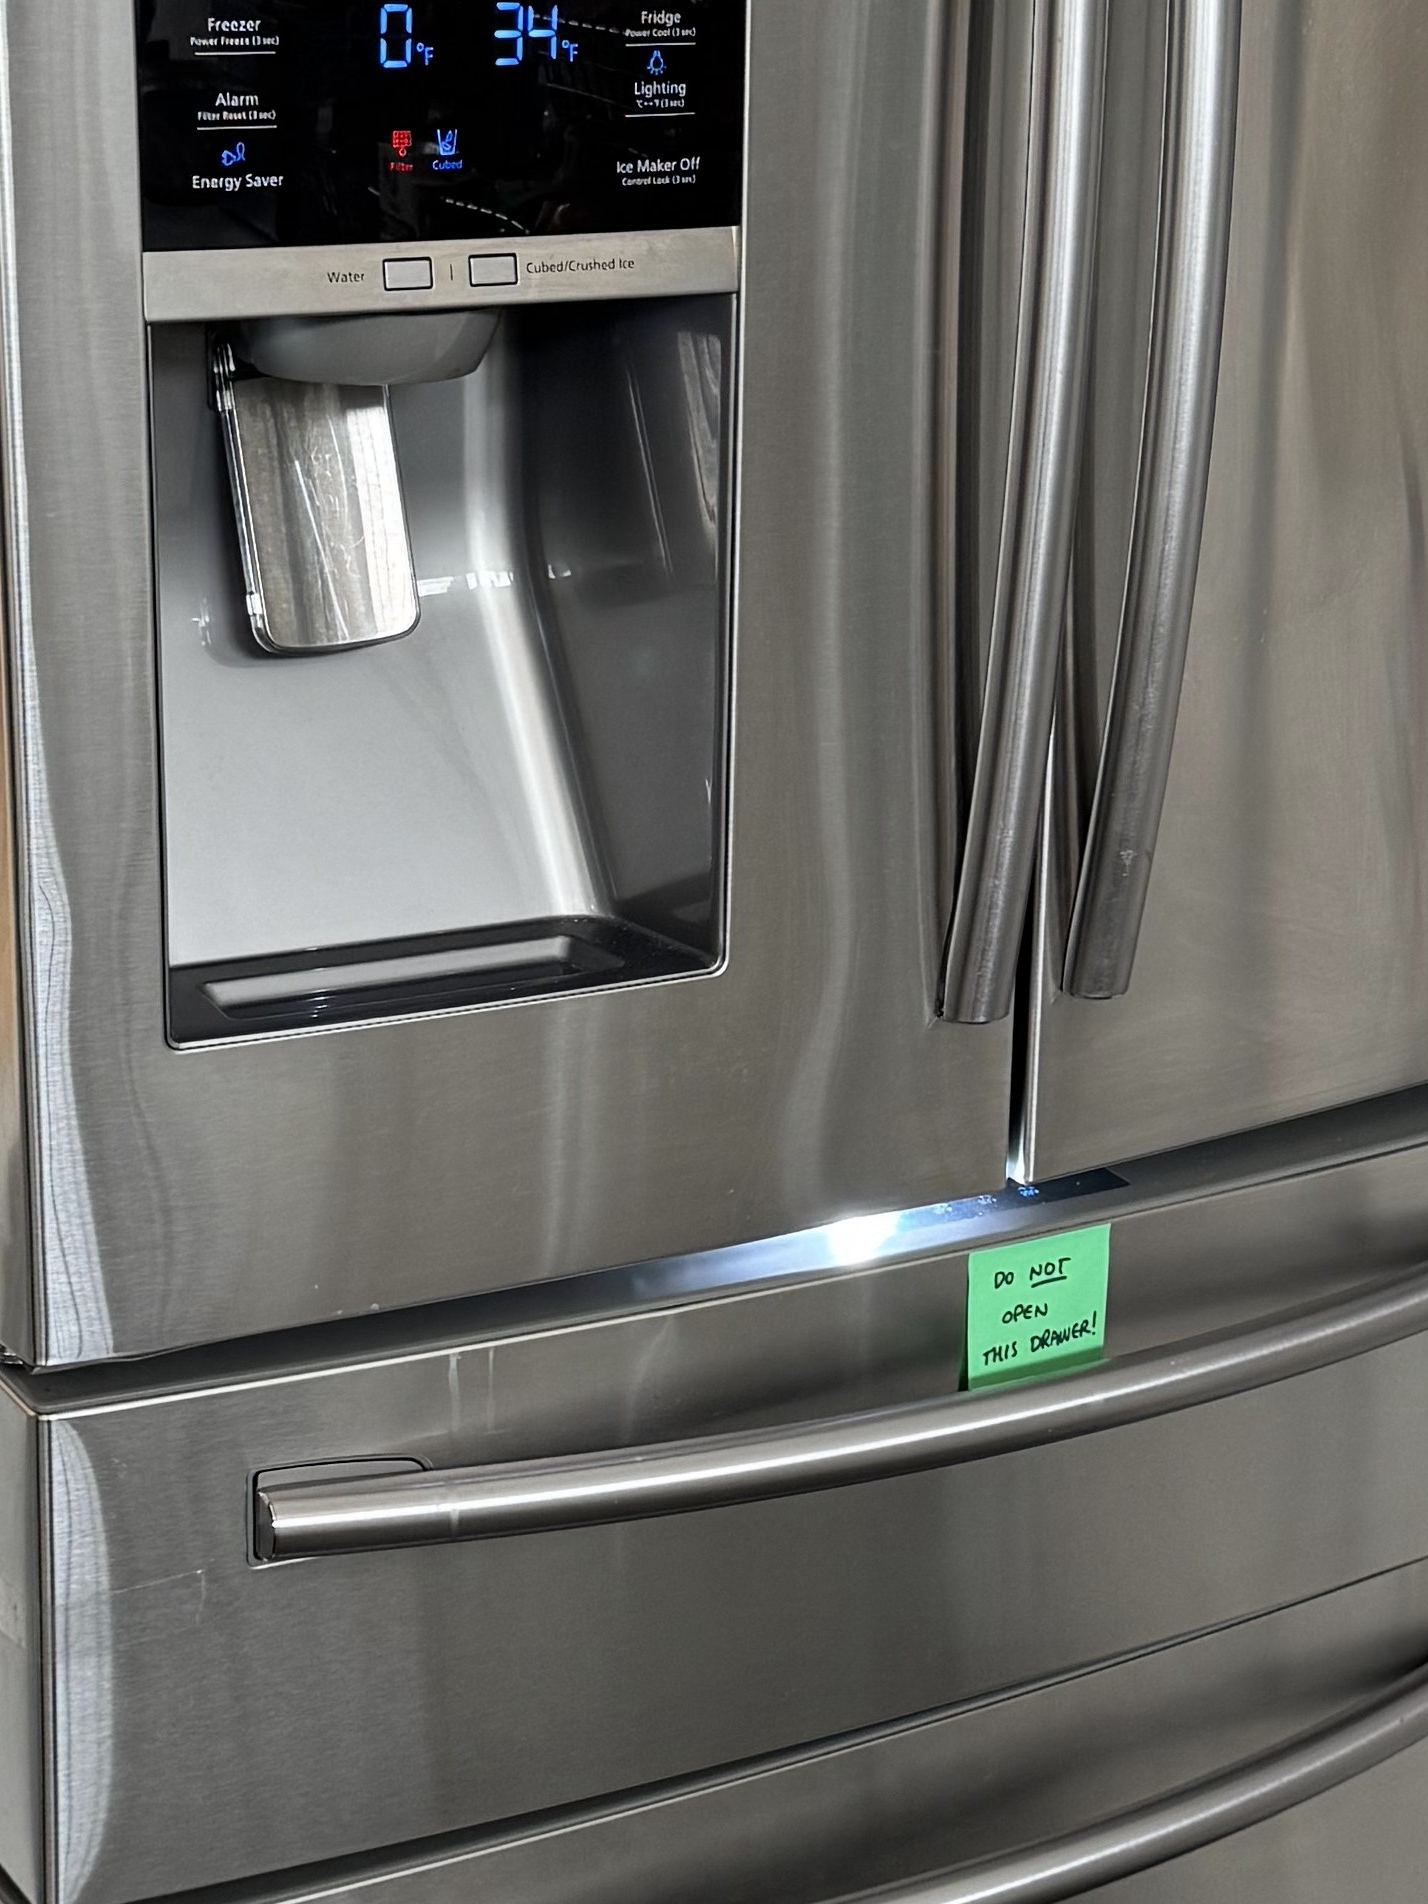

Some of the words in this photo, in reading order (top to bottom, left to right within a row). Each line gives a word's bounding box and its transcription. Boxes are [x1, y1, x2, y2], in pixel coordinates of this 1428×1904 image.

[207, 17, 262, 32] Freezer
[641, 10, 682, 27] Fridge
[634, 80, 687, 98] Lighting
[215, 92, 259, 107] Alarm
[432, 159, 463, 171] Cubed
[616, 160, 634, 174] Ice
[637, 158, 678, 173] Maker
[680, 156, 701, 171] Off
[192, 175, 242, 192] Energy
[245, 173, 284, 188] Saver
[525, 258, 616, 275] Cubed/Crushed
[619, 258, 636, 270] Ice
[326, 270, 366, 285] Water
[994, 1271, 1014, 1289] DO
[1029, 1257, 1071, 1281] NOT
[1001, 1302, 1049, 1324] OPEN
[982, 1340, 1018, 1366] THIS
[1029, 1310, 1097, 1353] DRAWER!
